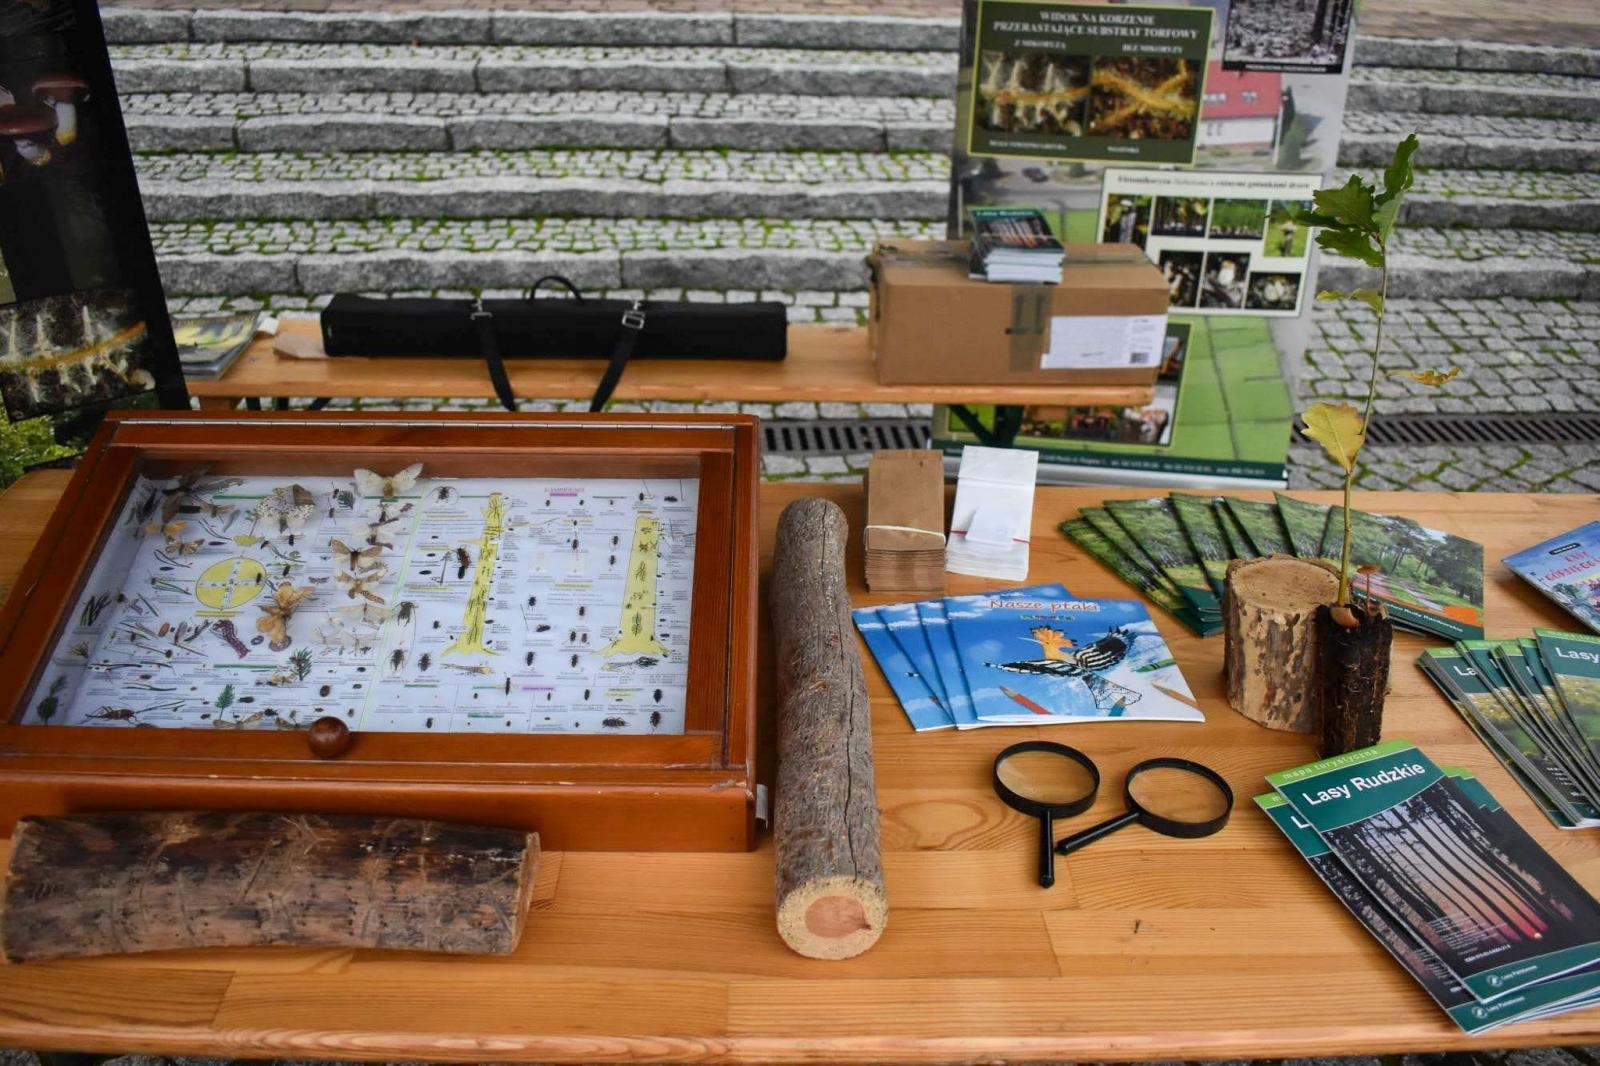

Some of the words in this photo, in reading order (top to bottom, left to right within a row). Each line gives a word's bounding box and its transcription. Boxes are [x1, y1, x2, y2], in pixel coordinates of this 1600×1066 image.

[1040, 12, 1079, 22] WIDOK
[1082, 13, 1097, 23] NA
[1099, 14, 1156, 25] KORZENIE
[993, 21, 1083, 35] PRZERASTAJĄCE
[1086, 25, 1141, 37] SUBSTRAT
[1144, 27, 1198, 39] TORFOWY
[990, 600, 1042, 609] Nasze
[1050, 602, 1098, 613] ptaki
[1555, 647, 1600, 664] Lasy
[1453, 665, 1478, 676] La
[1283, 767, 1312, 780] mapa
[1315, 749, 1379, 770] turystyczna
[1302, 784, 1352, 806] Lasy
[1350, 763, 1426, 792] Rudzkie
